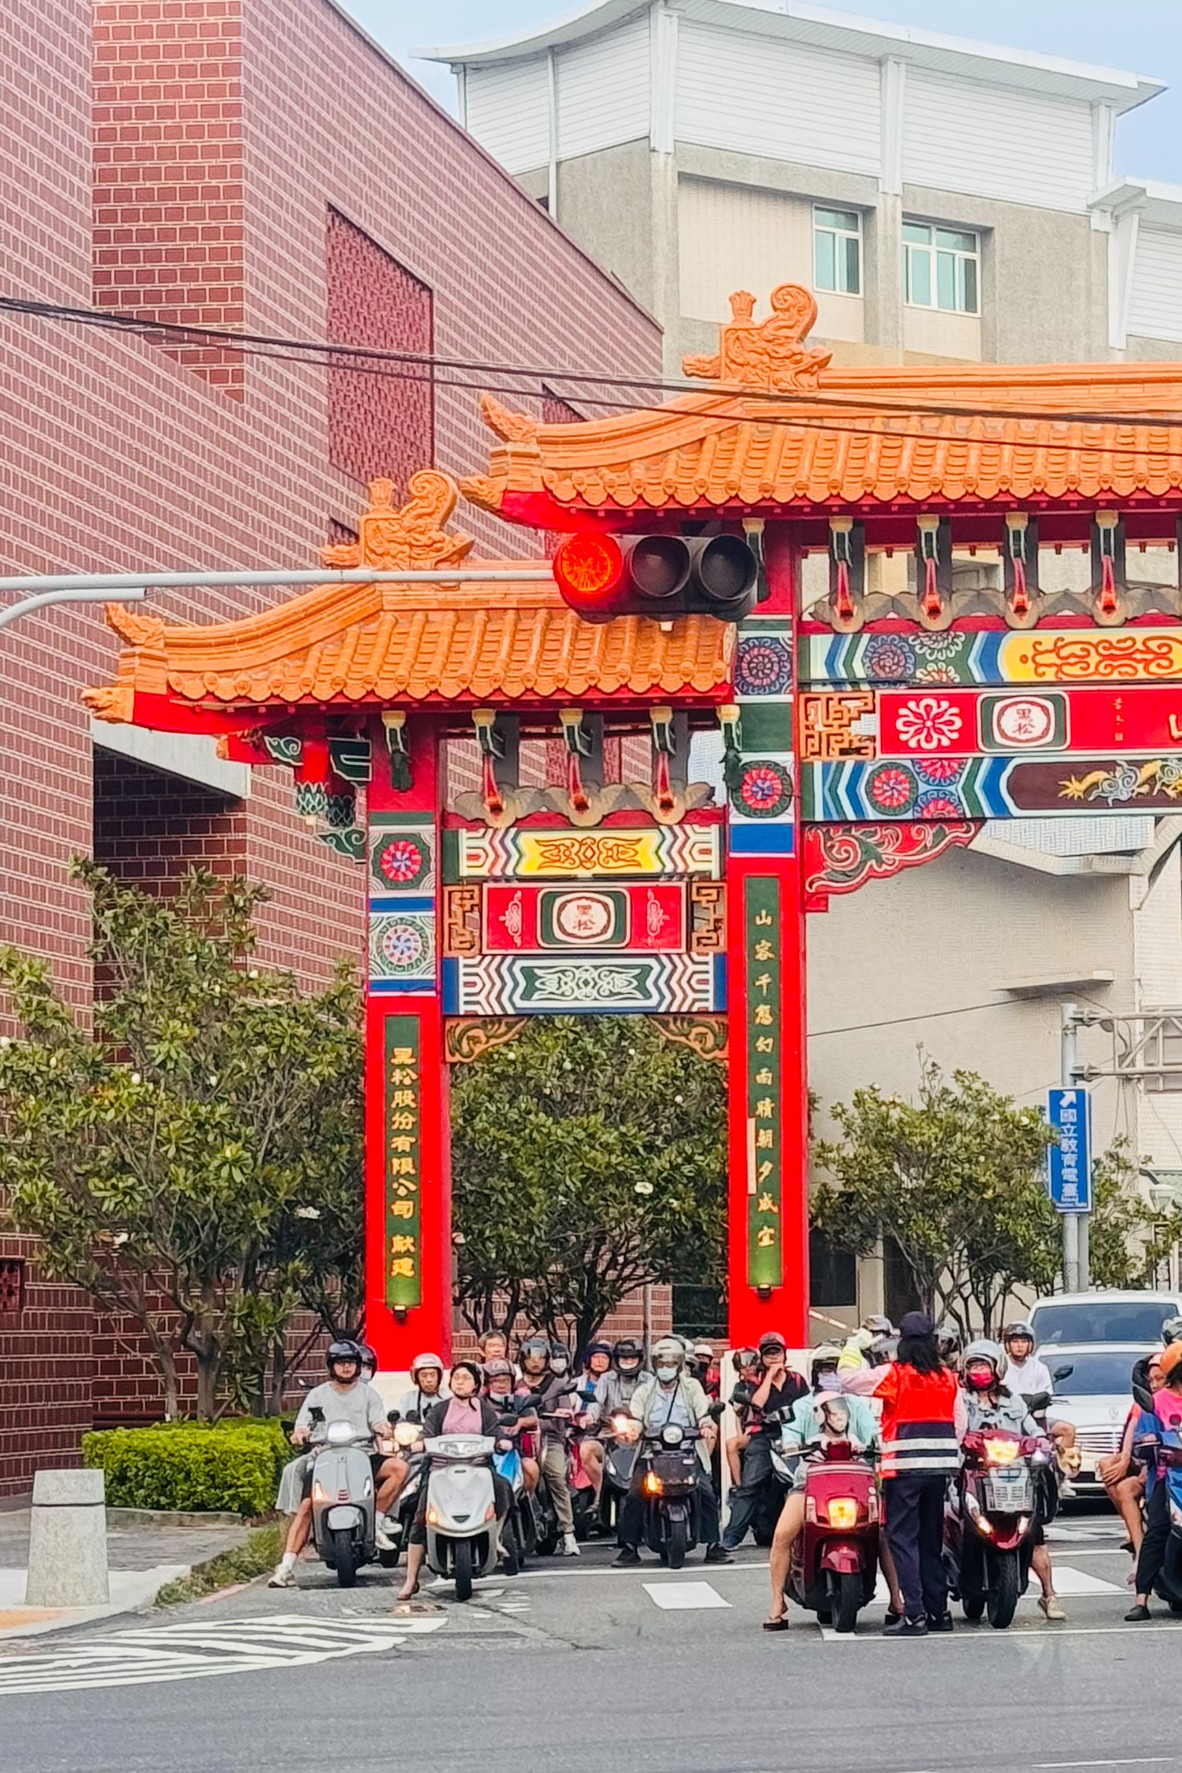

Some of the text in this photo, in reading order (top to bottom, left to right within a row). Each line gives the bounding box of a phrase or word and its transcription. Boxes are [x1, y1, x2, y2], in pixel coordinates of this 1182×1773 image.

[1013, 708, 1036, 736] 黑松
[571, 904, 597, 932] 黑松
[390, 1047, 418, 1220] 黑松股份有限公司
